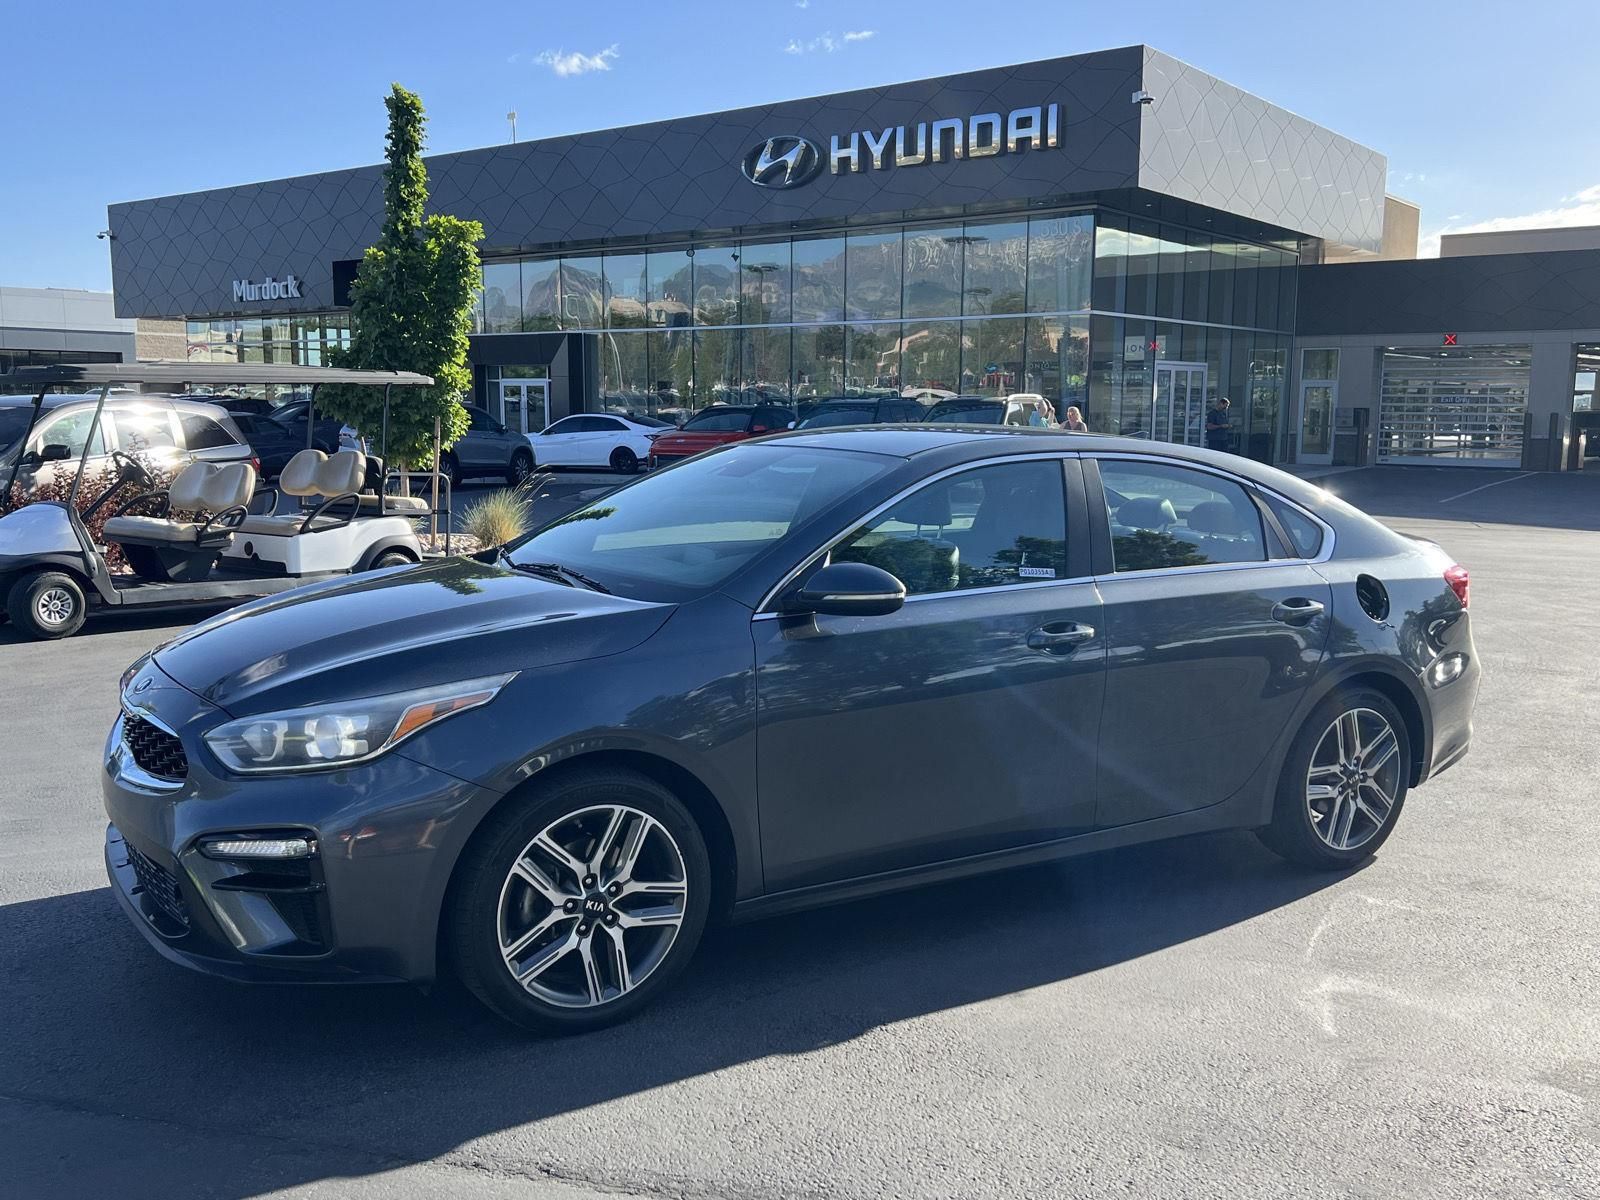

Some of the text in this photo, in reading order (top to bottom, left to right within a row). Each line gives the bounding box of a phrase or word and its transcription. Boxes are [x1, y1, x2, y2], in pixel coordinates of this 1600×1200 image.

[830, 103, 1062, 175] HYUNDAI
[233, 275, 301, 302] Murdock
[585, 900, 604, 912] KIA
